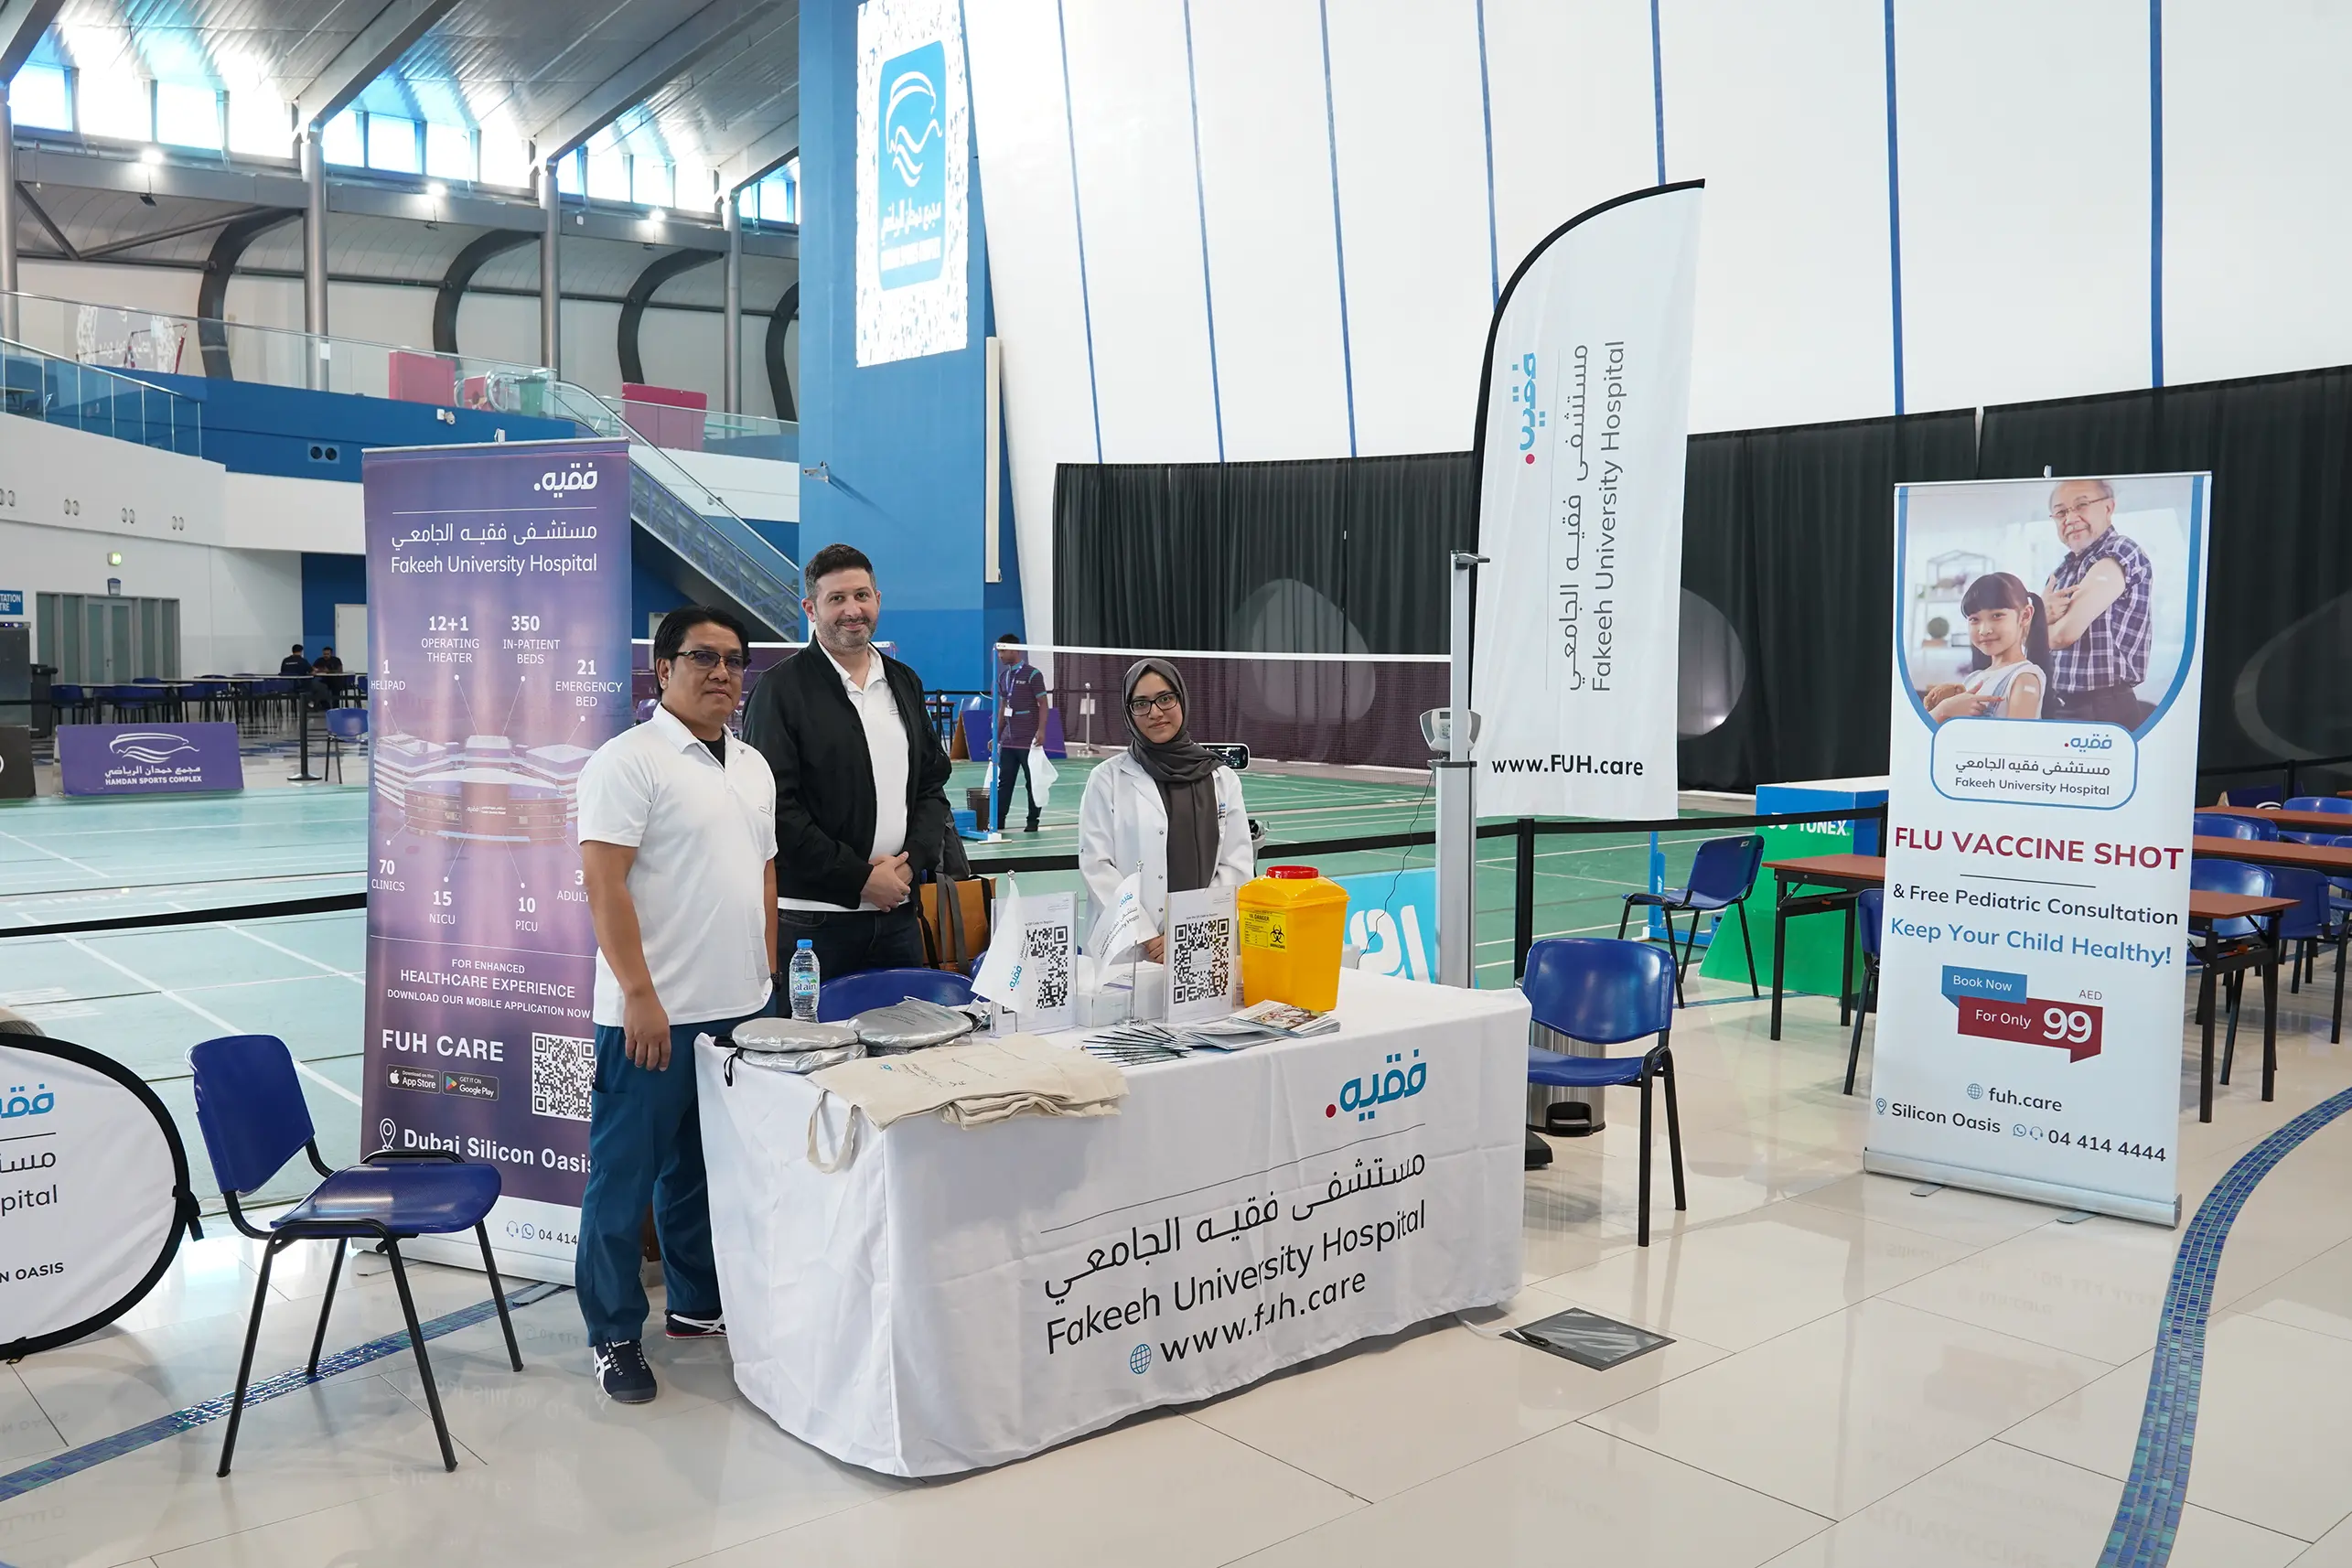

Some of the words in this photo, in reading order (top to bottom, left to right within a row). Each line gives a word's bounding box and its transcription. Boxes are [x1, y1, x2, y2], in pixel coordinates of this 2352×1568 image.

[1601, 341, 1627, 451] Hospital
[1563, 345, 1589, 481] مستشفى
[460, 523, 507, 545] فقيه
[512, 520, 597, 545] مستشفى
[1563, 495, 1585, 571] فقيه
[1595, 459, 1624, 590] University
[392, 523, 454, 551] الجامعي
[391, 556, 443, 574] Fakeeh
[448, 555, 525, 576] University
[530, 553, 597, 576] Hospital
[428, 616, 469, 632] 12+1
[510, 616, 541, 632] 350
[421, 638, 480, 650] OPERATING
[502, 639, 561, 650] IN-PATIENT
[1558, 584, 1586, 691] الجامعي
[1592, 600, 1613, 692] Fakeeh
[382, 660, 391, 674] 1
[426, 652, 473, 663] THEATER
[517, 653, 545, 665] BEDS
[576, 659, 597, 675] 21
[371, 680, 405, 691] HELIPAD
[555, 681, 623, 693] EMERGENCY
[575, 696, 597, 707] BED
[1491, 754, 1644, 776] www.FUH.care
[1955, 757, 2005, 774] الجامعي
[2008, 760, 2039, 774] فقيه
[2042, 760, 2110, 776] مستشفى
[105, 777, 138, 786] HAMDAN
[139, 776, 167, 785] SPORTS
[169, 775, 202, 784] COMPLEX
[1955, 777, 1995, 789] Fakeeh
[1999, 779, 2057, 795] University
[2059, 783, 2110, 797] Hospital
[1895, 826, 1943, 851] FLU
[1951, 831, 2084, 863] VACCINE
[2093, 843, 2185, 870] SHOT
[379, 859, 395, 875] 70
[371, 878, 405, 892] CLINICS
[433, 891, 452, 906] 15
[518, 897, 536, 913] 10
[1893, 883, 1906, 898] &
[1909, 885, 1949, 903] Free
[1955, 889, 2041, 913] Pediatric
[2047, 898, 2178, 925] Consultation
[429, 914, 456, 925] NICU
[515, 919, 538, 932] PICU
[1891, 918, 1941, 943] Keep
[1948, 923, 2000, 945] Your
[2006, 930, 2064, 952] Child
[2072, 936, 2172, 968] Healthy!
[452, 959, 472, 969] FOR
[475, 961, 525, 973] ENHANCED
[401, 969, 489, 989] HEALTHCARE
[492, 978, 575, 999] EXPERIENCE
[1953, 974, 1983, 988] Book
[1985, 979, 2013, 992] Now
[387, 989, 439, 1003] DOWNLOAD
[442, 994, 464, 1004] OUR
[467, 997, 502, 1009] MOBILE
[504, 1001, 564, 1016] APPLICATION
[567, 1008, 591, 1019] NOW
[2078, 989, 2103, 1001] AED
[1975, 1009, 1997, 1022] For
[2000, 1013, 2032, 1030] Only
[2042, 1007, 2093, 1044] 99
[382, 1028, 427, 1054] FUH
[436, 1035, 504, 1062] CARE
[403, 1078, 416, 1088] App
[417, 1079, 436, 1089] Store
[459, 1084, 481, 1095] Google
[481, 1087, 495, 1098] Play
[1988, 1087, 2063, 1112] fuh.care
[1891, 1102, 1947, 1124] Silicon
[1951, 1112, 2001, 1133] Oasis
[403, 1128, 460, 1155] Dubai
[467, 1137, 534, 1165] Silicon
[541, 1148, 591, 1173] Oasi
[2047, 1130, 2070, 1146] 04
[2077, 1134, 2112, 1153] 414
[2118, 1142, 2166, 1162] 4444
[1293, 1153, 1426, 1221] مستشفى
[1196, 1191, 1279, 1242] فقيه
[539, 1229, 553, 1241] 04
[556, 1232, 578, 1245] 414
[1044, 1216, 1181, 1305] الجامعي
[15, 1262, 64, 1281] OASIS
[1046, 1287, 1160, 1355] Fakeeh
[1174, 1244, 1313, 1311] University
[1323, 1199, 1426, 1262] Hospital
